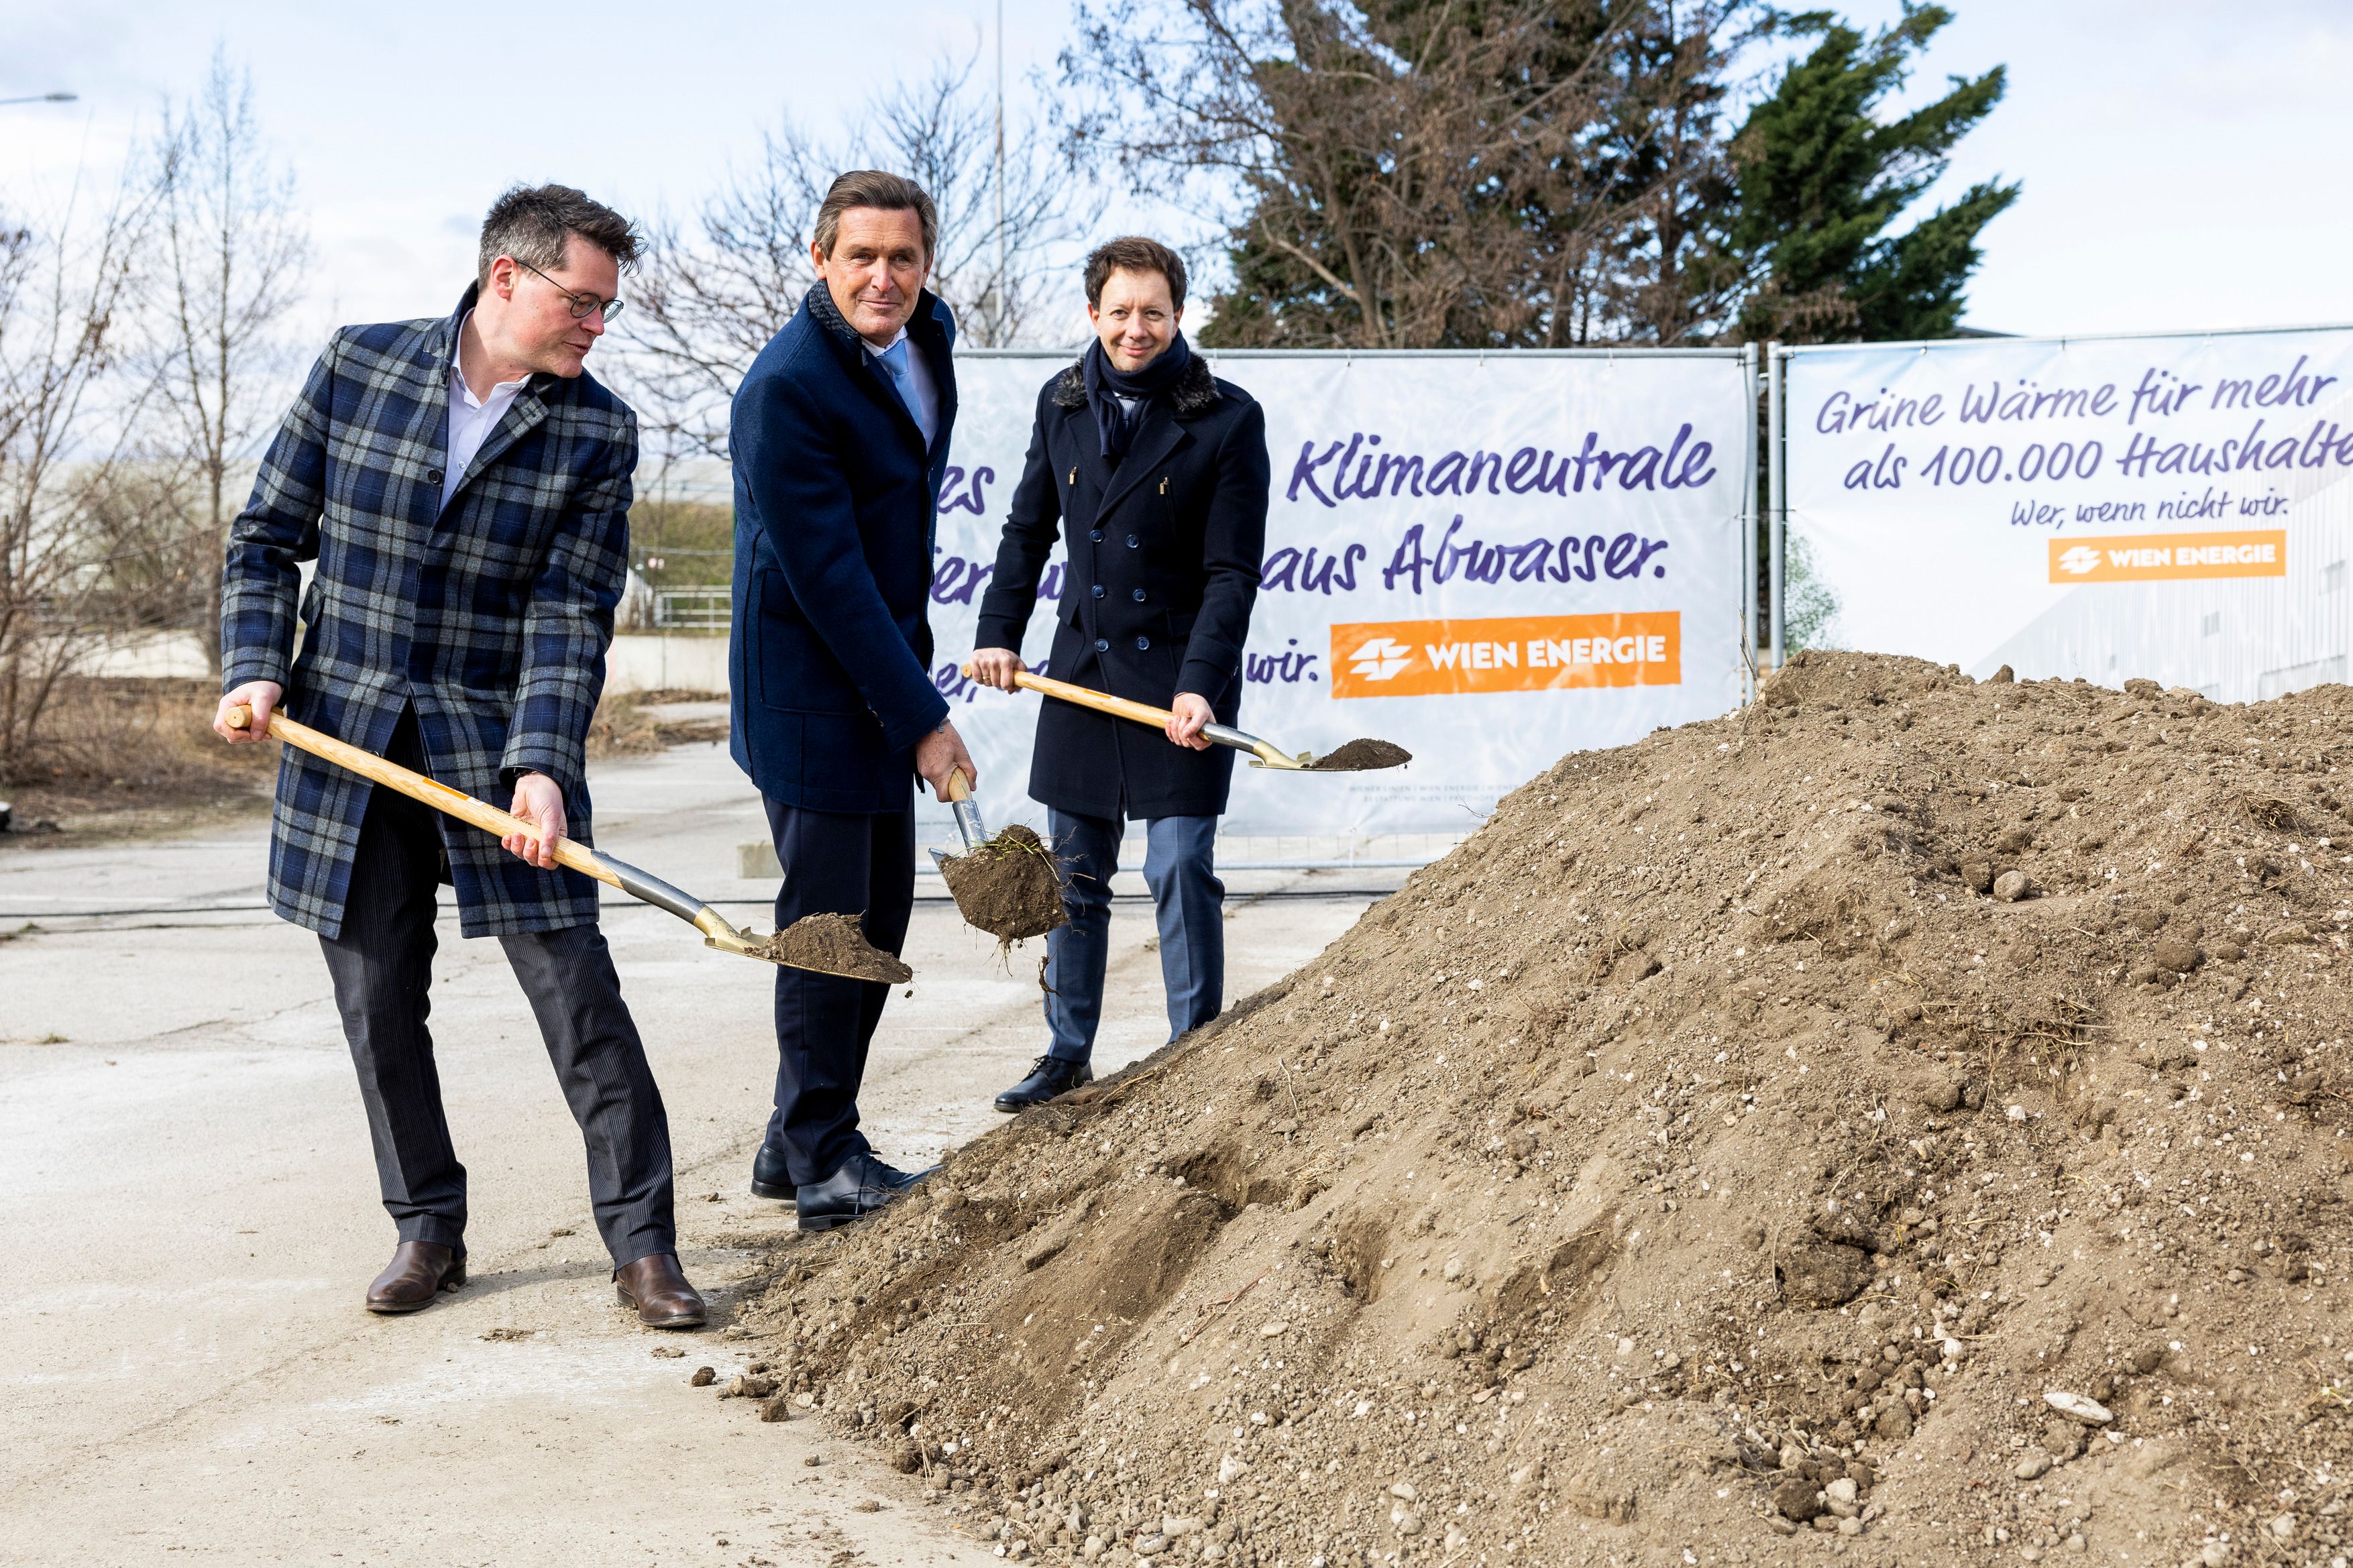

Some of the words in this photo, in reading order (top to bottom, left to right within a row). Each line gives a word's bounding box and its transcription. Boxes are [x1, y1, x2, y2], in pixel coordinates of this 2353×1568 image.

[1816, 387, 1946, 435] Grüne
[1959, 379, 2119, 424] Wärme
[2127, 368, 2203, 425] für
[2210, 355, 2338, 409] mehr
[1287, 423, 1716, 508] Klimaneutrale
[1844, 443, 1908, 490] als
[1920, 439, 2103, 487] 100.000
[2011, 500, 2065, 530] Wer,
[2076, 503, 2147, 522] wenn
[2157, 488, 2234, 520] nicht
[2240, 488, 2290, 516] wir.
[1259, 544, 1366, 596] aus
[1382, 514, 1666, 595] Abwasser.
[2108, 547, 2171, 569] WIEN
[2175, 544, 2276, 565] ENERGIE
[1246, 639, 1318, 683] wir.
[1425, 642, 1519, 671] WIEN
[1527, 636, 1666, 665] ENERGIE
[492, 806, 511, 816] AUSTRIA
